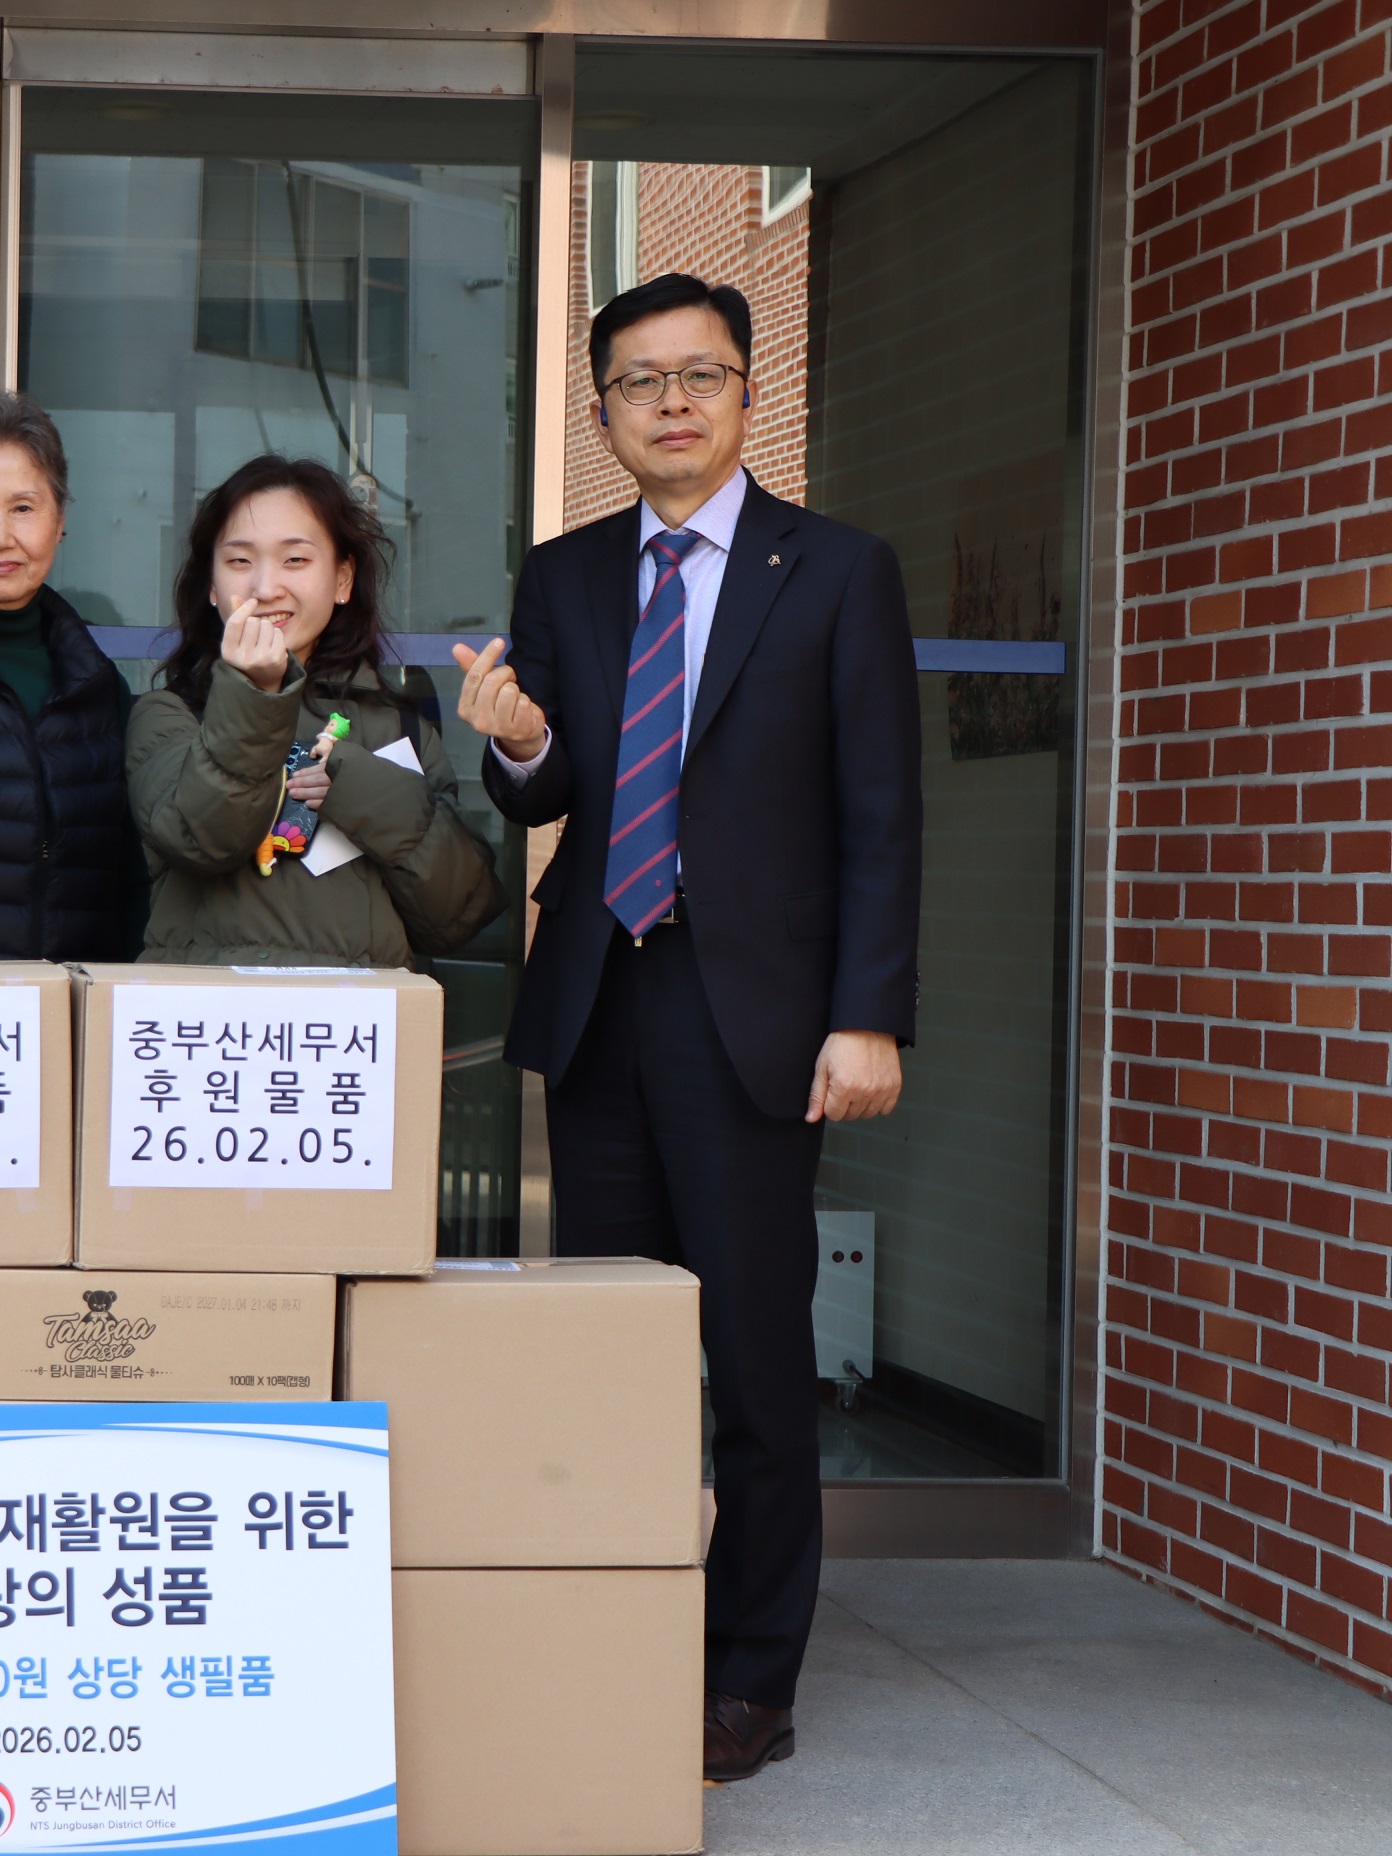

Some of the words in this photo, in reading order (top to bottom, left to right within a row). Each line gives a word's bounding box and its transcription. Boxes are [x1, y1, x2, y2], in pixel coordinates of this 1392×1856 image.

[128, 1020, 378, 1064] 중부산세무서
[131, 1126, 372, 1167] 26.02.05.
[43, 1312, 156, 1348] Tamsaa
[65, 1338, 135, 1363] Classic
[50, 1365, 108, 1379] 탐사클래식
[110, 1365, 144, 1380] 물티슈
[229, 1375, 255, 1387] 100매
[267, 1375, 311, 1388] 10팩(캡형)
[244, 1490, 355, 1552] 위한
[101, 1566, 213, 1627] 성품
[66, 1656, 143, 1700] 상당
[160, 1654, 275, 1699] 생필품
[30, 1784, 176, 1813] 중부산세무서
[30, 1821, 50, 1831] NTS
[52, 1821, 105, 1832] Jungbusan
[108, 1819, 143, 1830] District
[145, 1819, 177, 1830] Office
